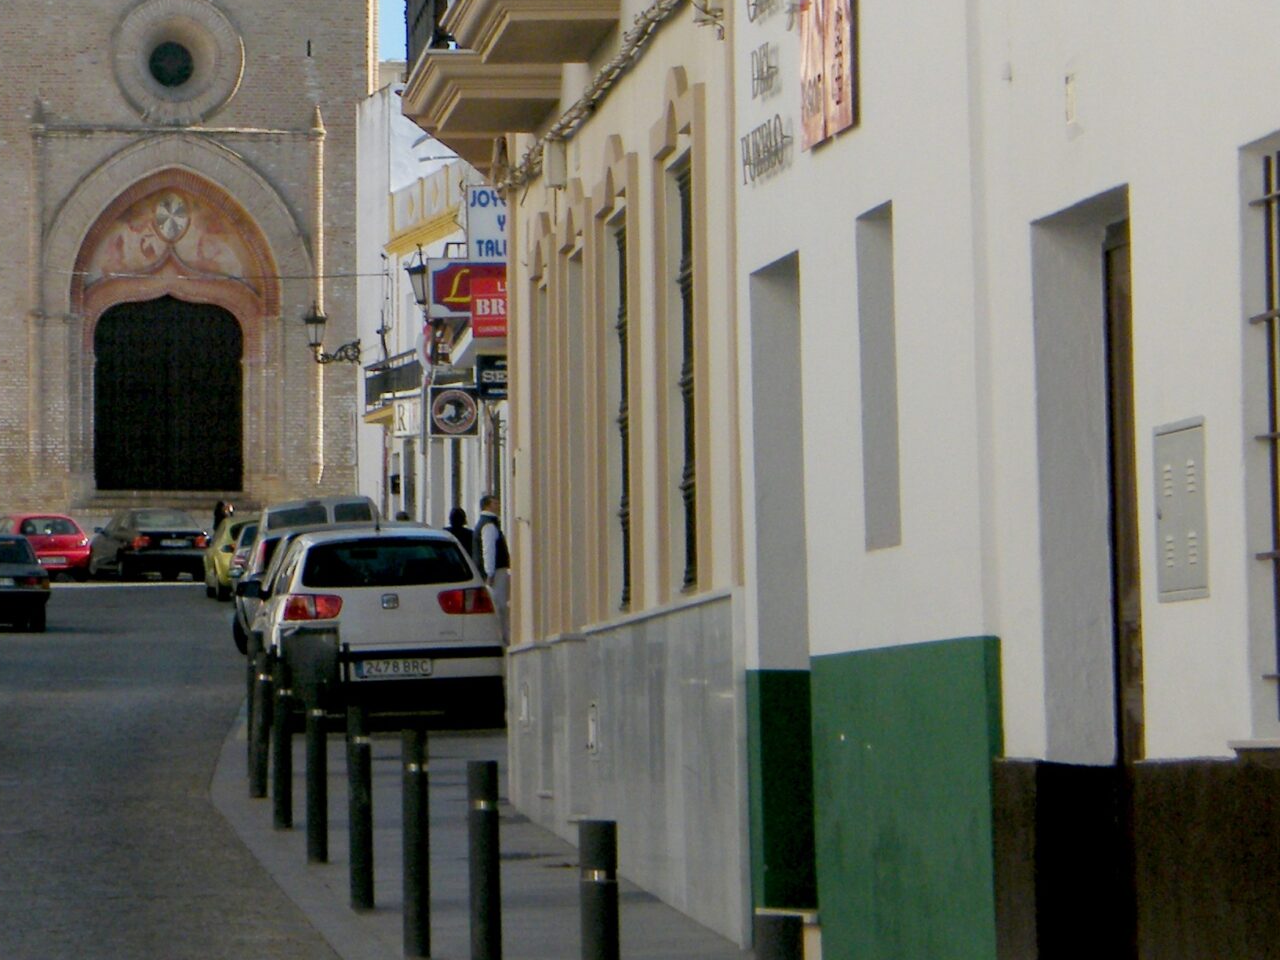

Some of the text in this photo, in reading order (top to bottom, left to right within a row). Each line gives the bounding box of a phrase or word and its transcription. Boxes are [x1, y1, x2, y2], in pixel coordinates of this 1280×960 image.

[751, 42, 774, 100] DEL
[740, 113, 784, 186] PUEBLO
[497, 214, 506, 232] Y
[497, 281, 507, 292] L
[476, 298, 506, 315] BR
[366, 660, 429, 674] 2478 BRC
